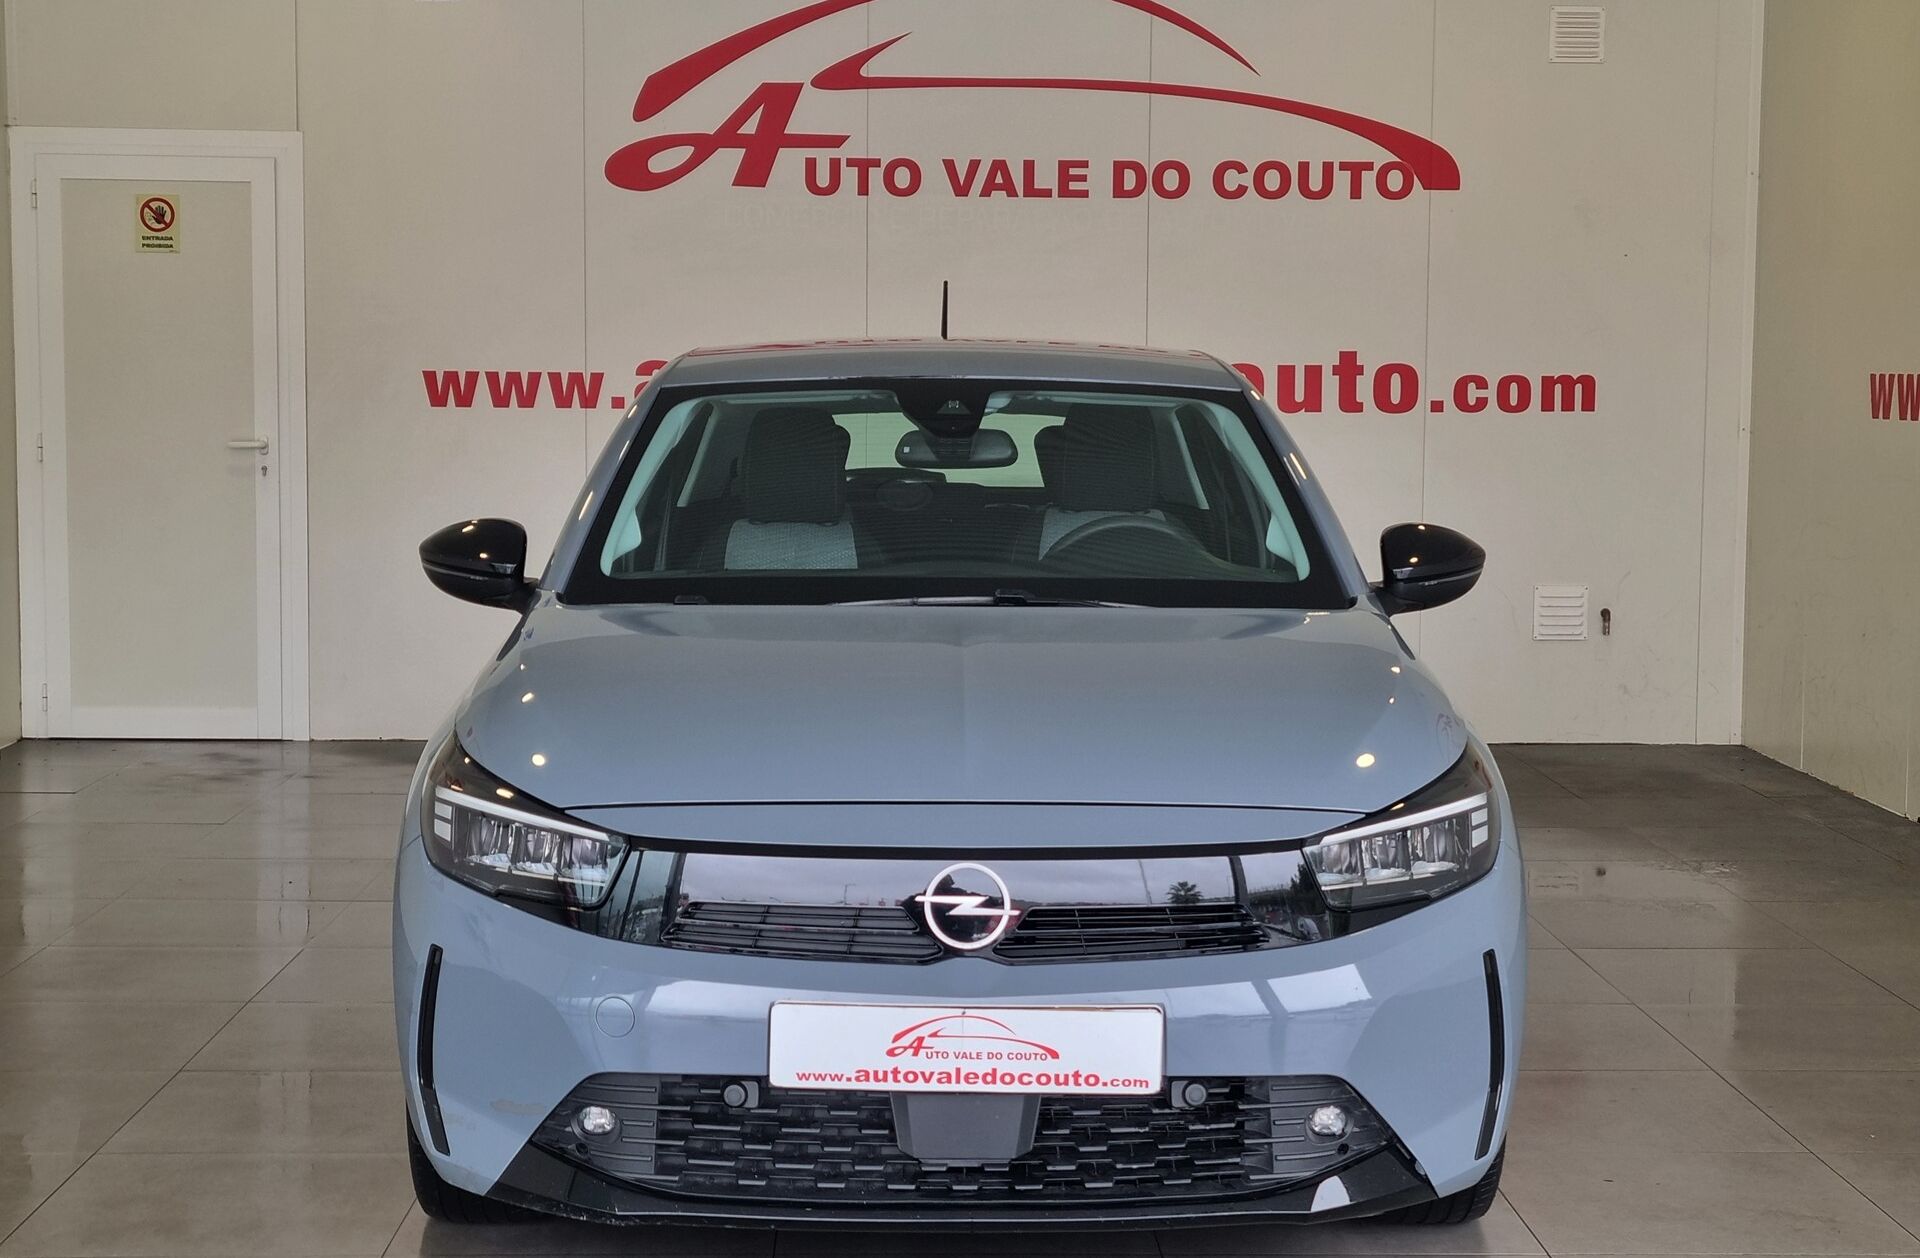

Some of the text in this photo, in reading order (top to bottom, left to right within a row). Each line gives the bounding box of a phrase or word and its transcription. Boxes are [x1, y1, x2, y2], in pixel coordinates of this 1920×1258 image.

[604, 81, 1415, 202] AUTO VALE DO COUTO
[886, 1036, 1048, 1061] AUTO VALE DO COUTO
[795, 1066, 1150, 1089] www.autovaledocouto.com
